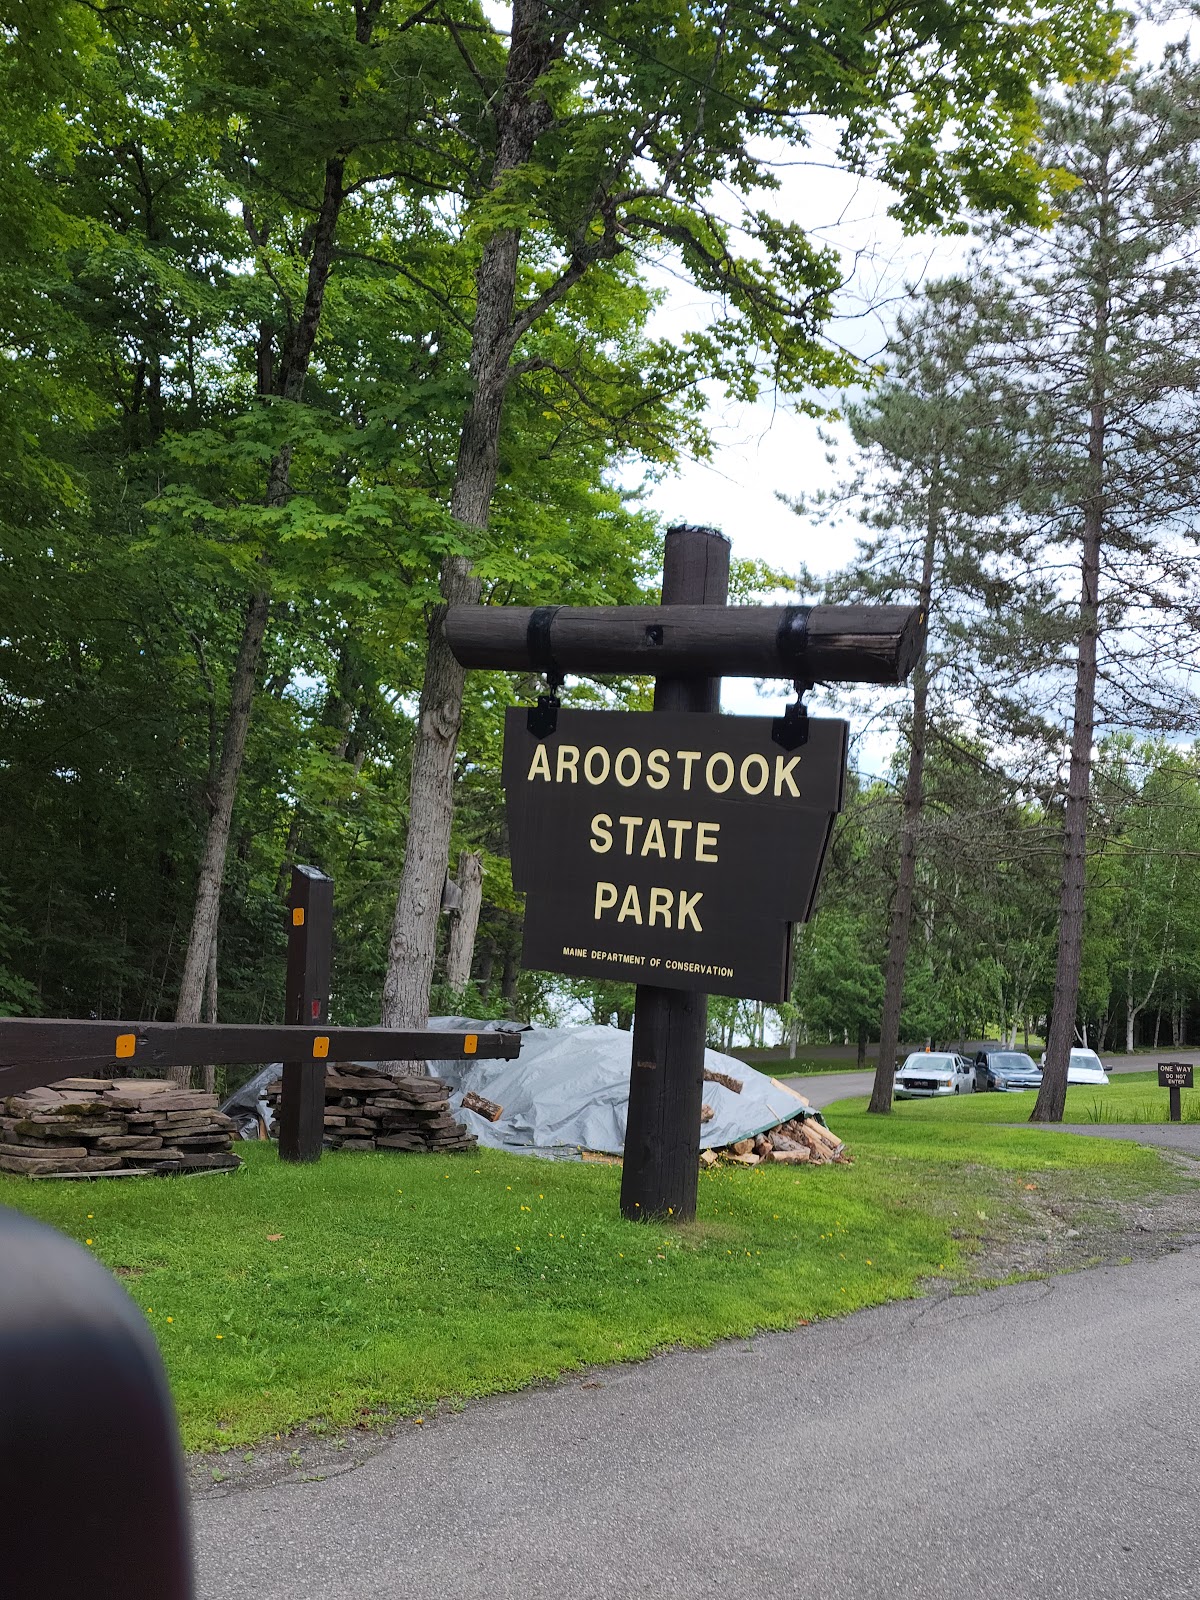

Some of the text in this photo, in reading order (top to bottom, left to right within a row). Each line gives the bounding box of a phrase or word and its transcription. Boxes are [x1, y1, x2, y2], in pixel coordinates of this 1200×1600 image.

[527, 744, 802, 798] AROOSTOOK
[590, 813, 720, 863] STATE
[594, 881, 704, 932] PARK
[563, 947, 734, 978] MAINE DEPARTMENT OF CONSERVATION
